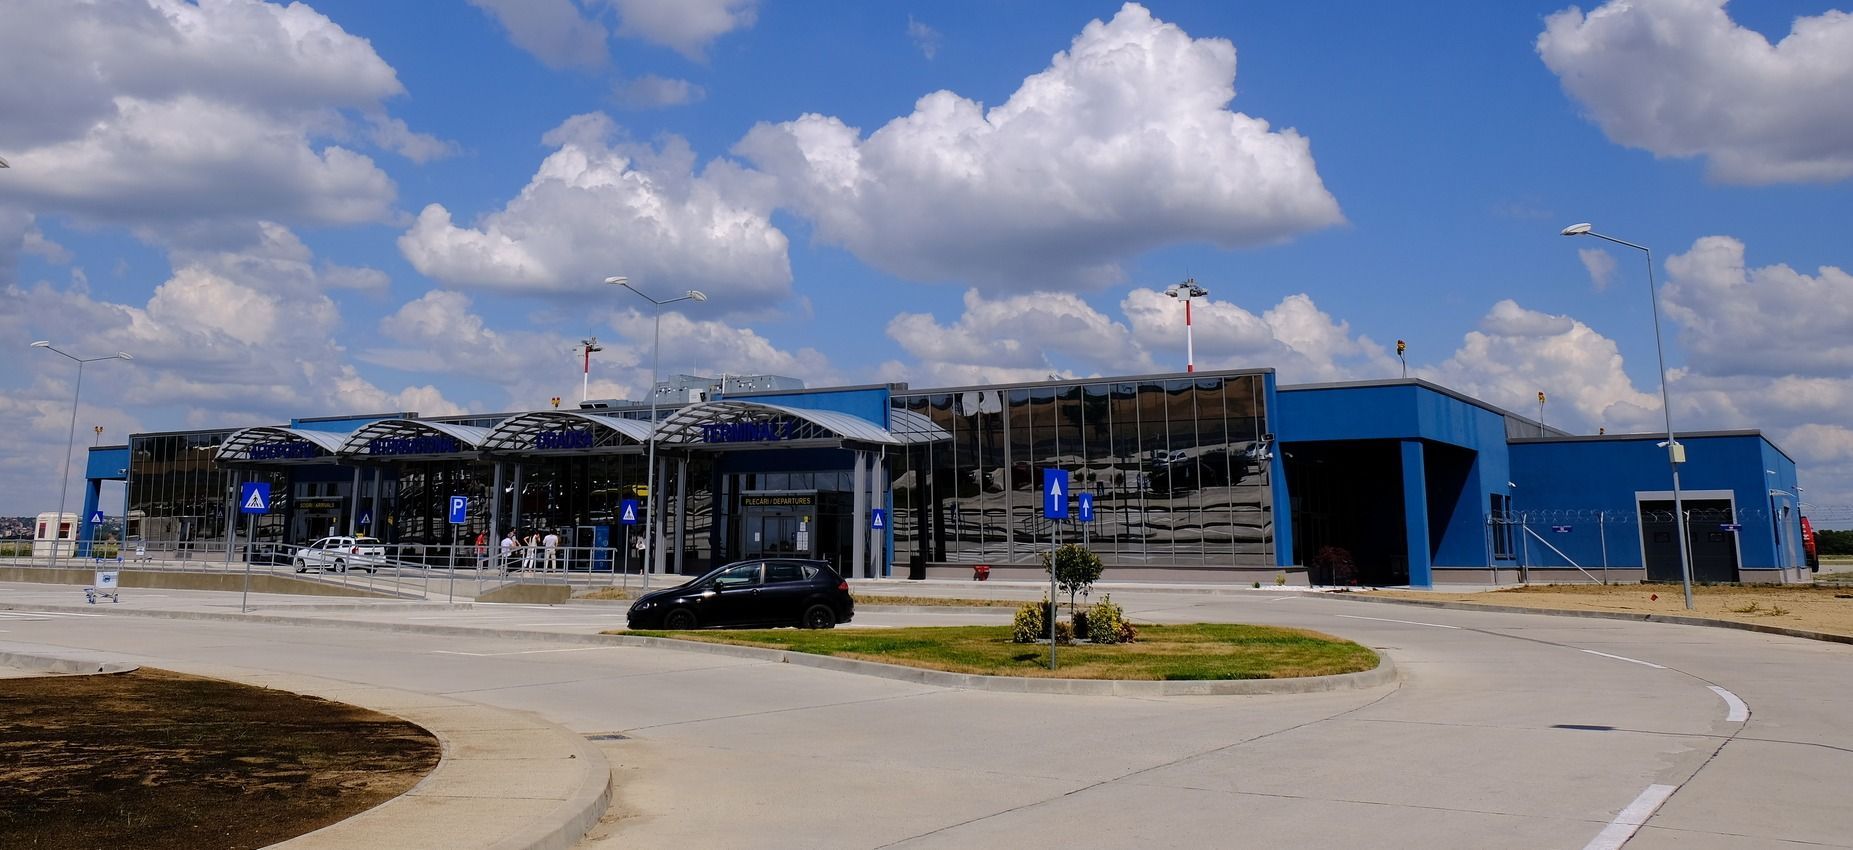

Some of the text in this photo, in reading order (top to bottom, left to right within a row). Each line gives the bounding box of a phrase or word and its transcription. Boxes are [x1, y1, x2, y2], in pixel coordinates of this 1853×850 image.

[536, 431, 594, 449] ORADEA
[702, 421, 780, 442] TERMINAL
[453, 499, 463, 515] P
